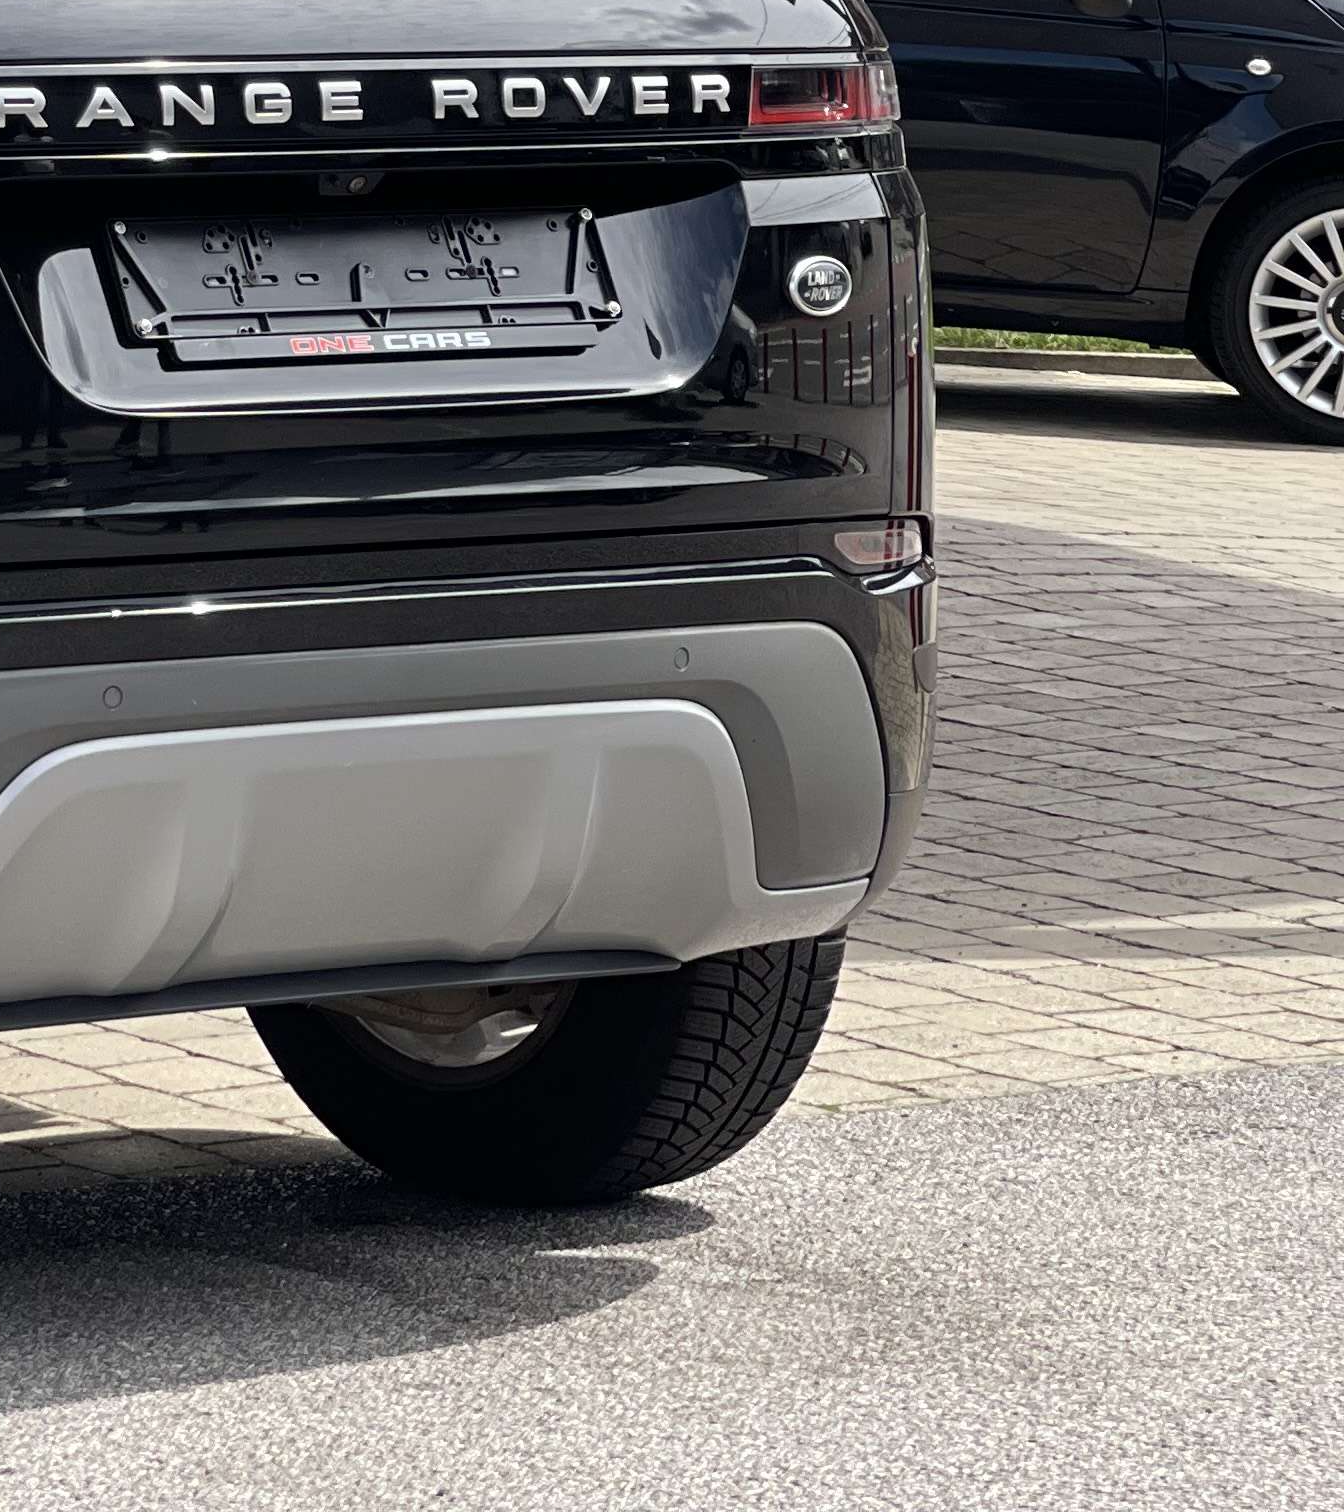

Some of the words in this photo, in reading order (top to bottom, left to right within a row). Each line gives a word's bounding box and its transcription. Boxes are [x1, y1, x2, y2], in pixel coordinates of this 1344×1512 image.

[431, 74, 731, 123] ROVER
[807, 270, 835, 286] LAND
[810, 285, 843, 302] ROVER
[288, 335, 375, 355] ONE
[383, 331, 491, 351] CARS
